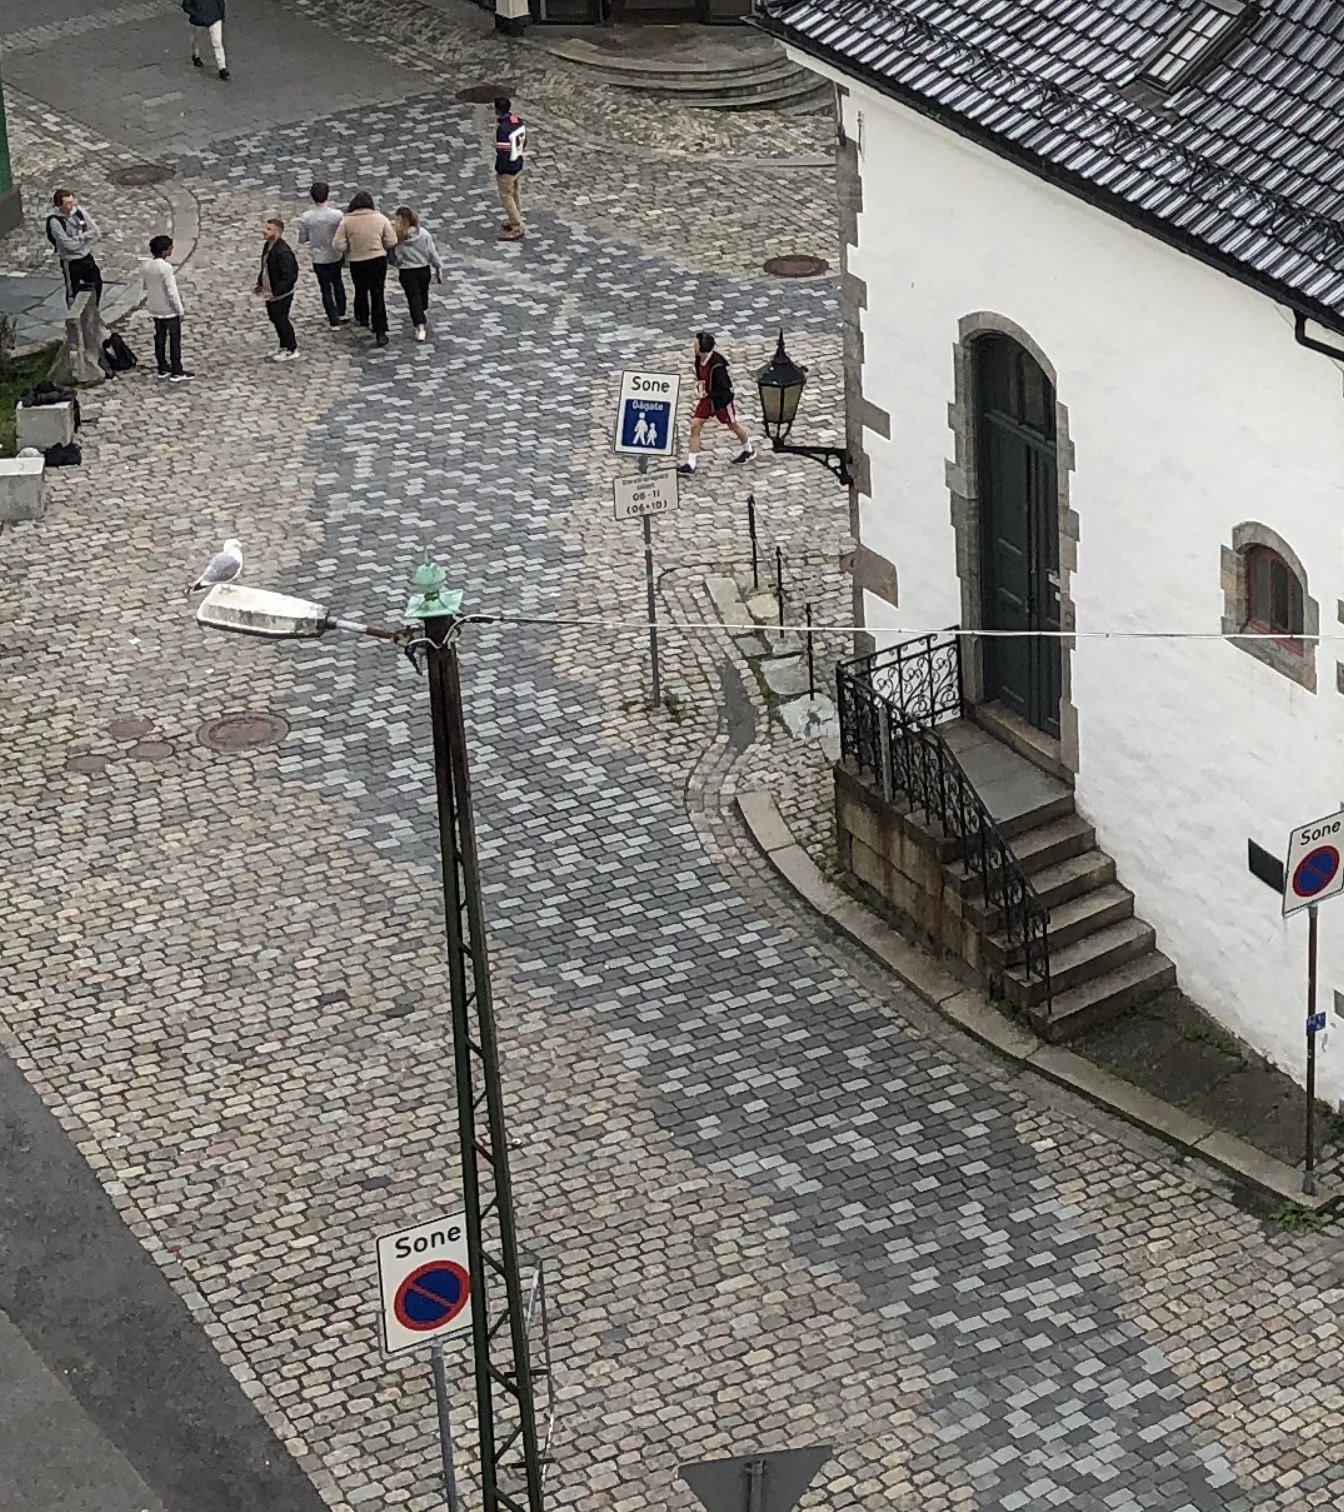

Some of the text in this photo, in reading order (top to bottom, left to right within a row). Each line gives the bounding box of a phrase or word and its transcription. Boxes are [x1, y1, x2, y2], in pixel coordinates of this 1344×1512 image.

[631, 376, 670, 393] Sone
[1300, 821, 1341, 846] Sone
[395, 1226, 461, 1258] Sone
